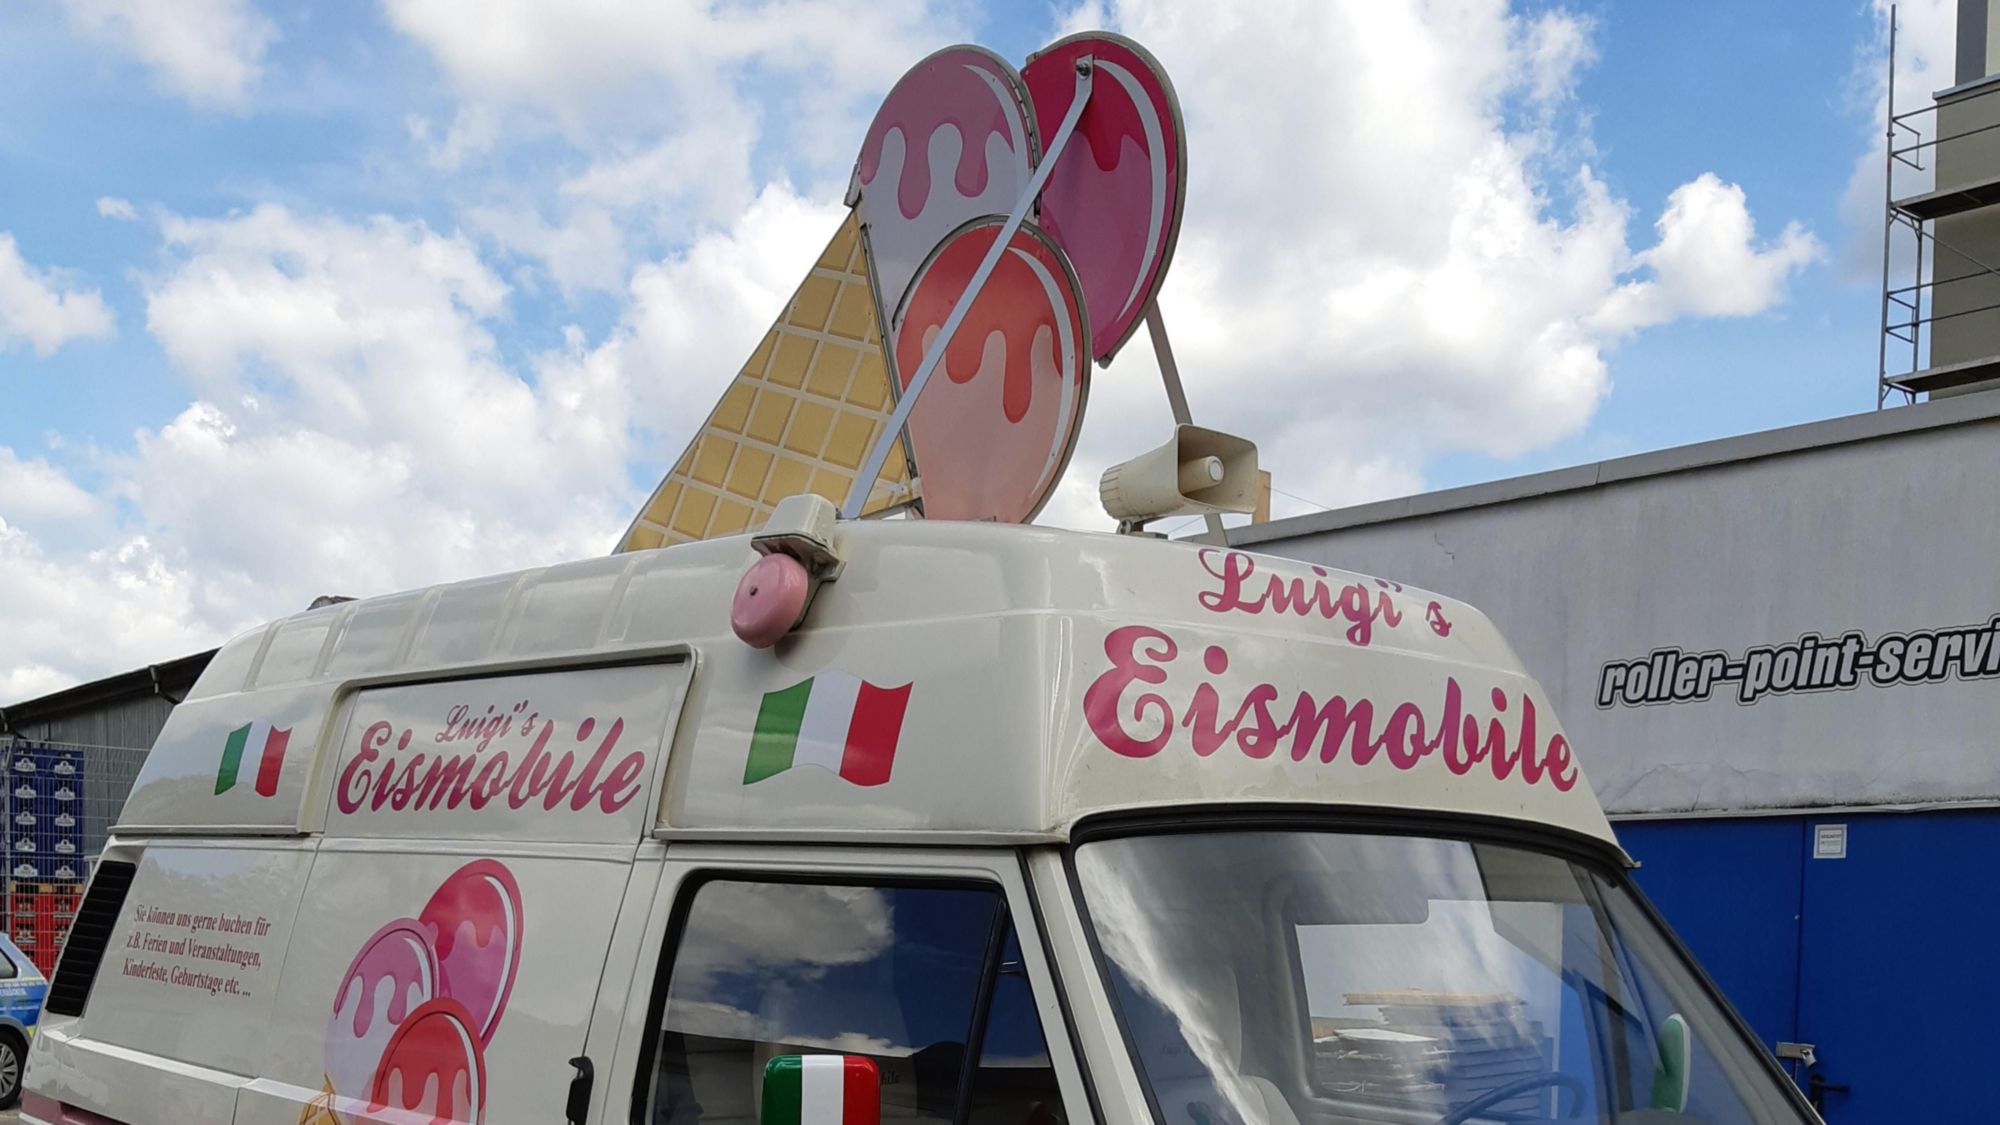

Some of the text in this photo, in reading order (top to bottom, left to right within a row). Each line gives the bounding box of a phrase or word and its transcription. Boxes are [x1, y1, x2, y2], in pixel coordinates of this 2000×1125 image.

[1083, 625, 1578, 792] Eismobile
[337, 717, 645, 814] Eismobile
[134, 904, 271, 937] Sie können uns gerne buchen für
[142, 932, 168, 953] Ferien
[168, 937, 187, 956] und
[187, 938, 262, 971] Veranstaltungen,
[122, 957, 169, 985] Kinderfeste,
[170, 965, 224, 996] Geburtstage
